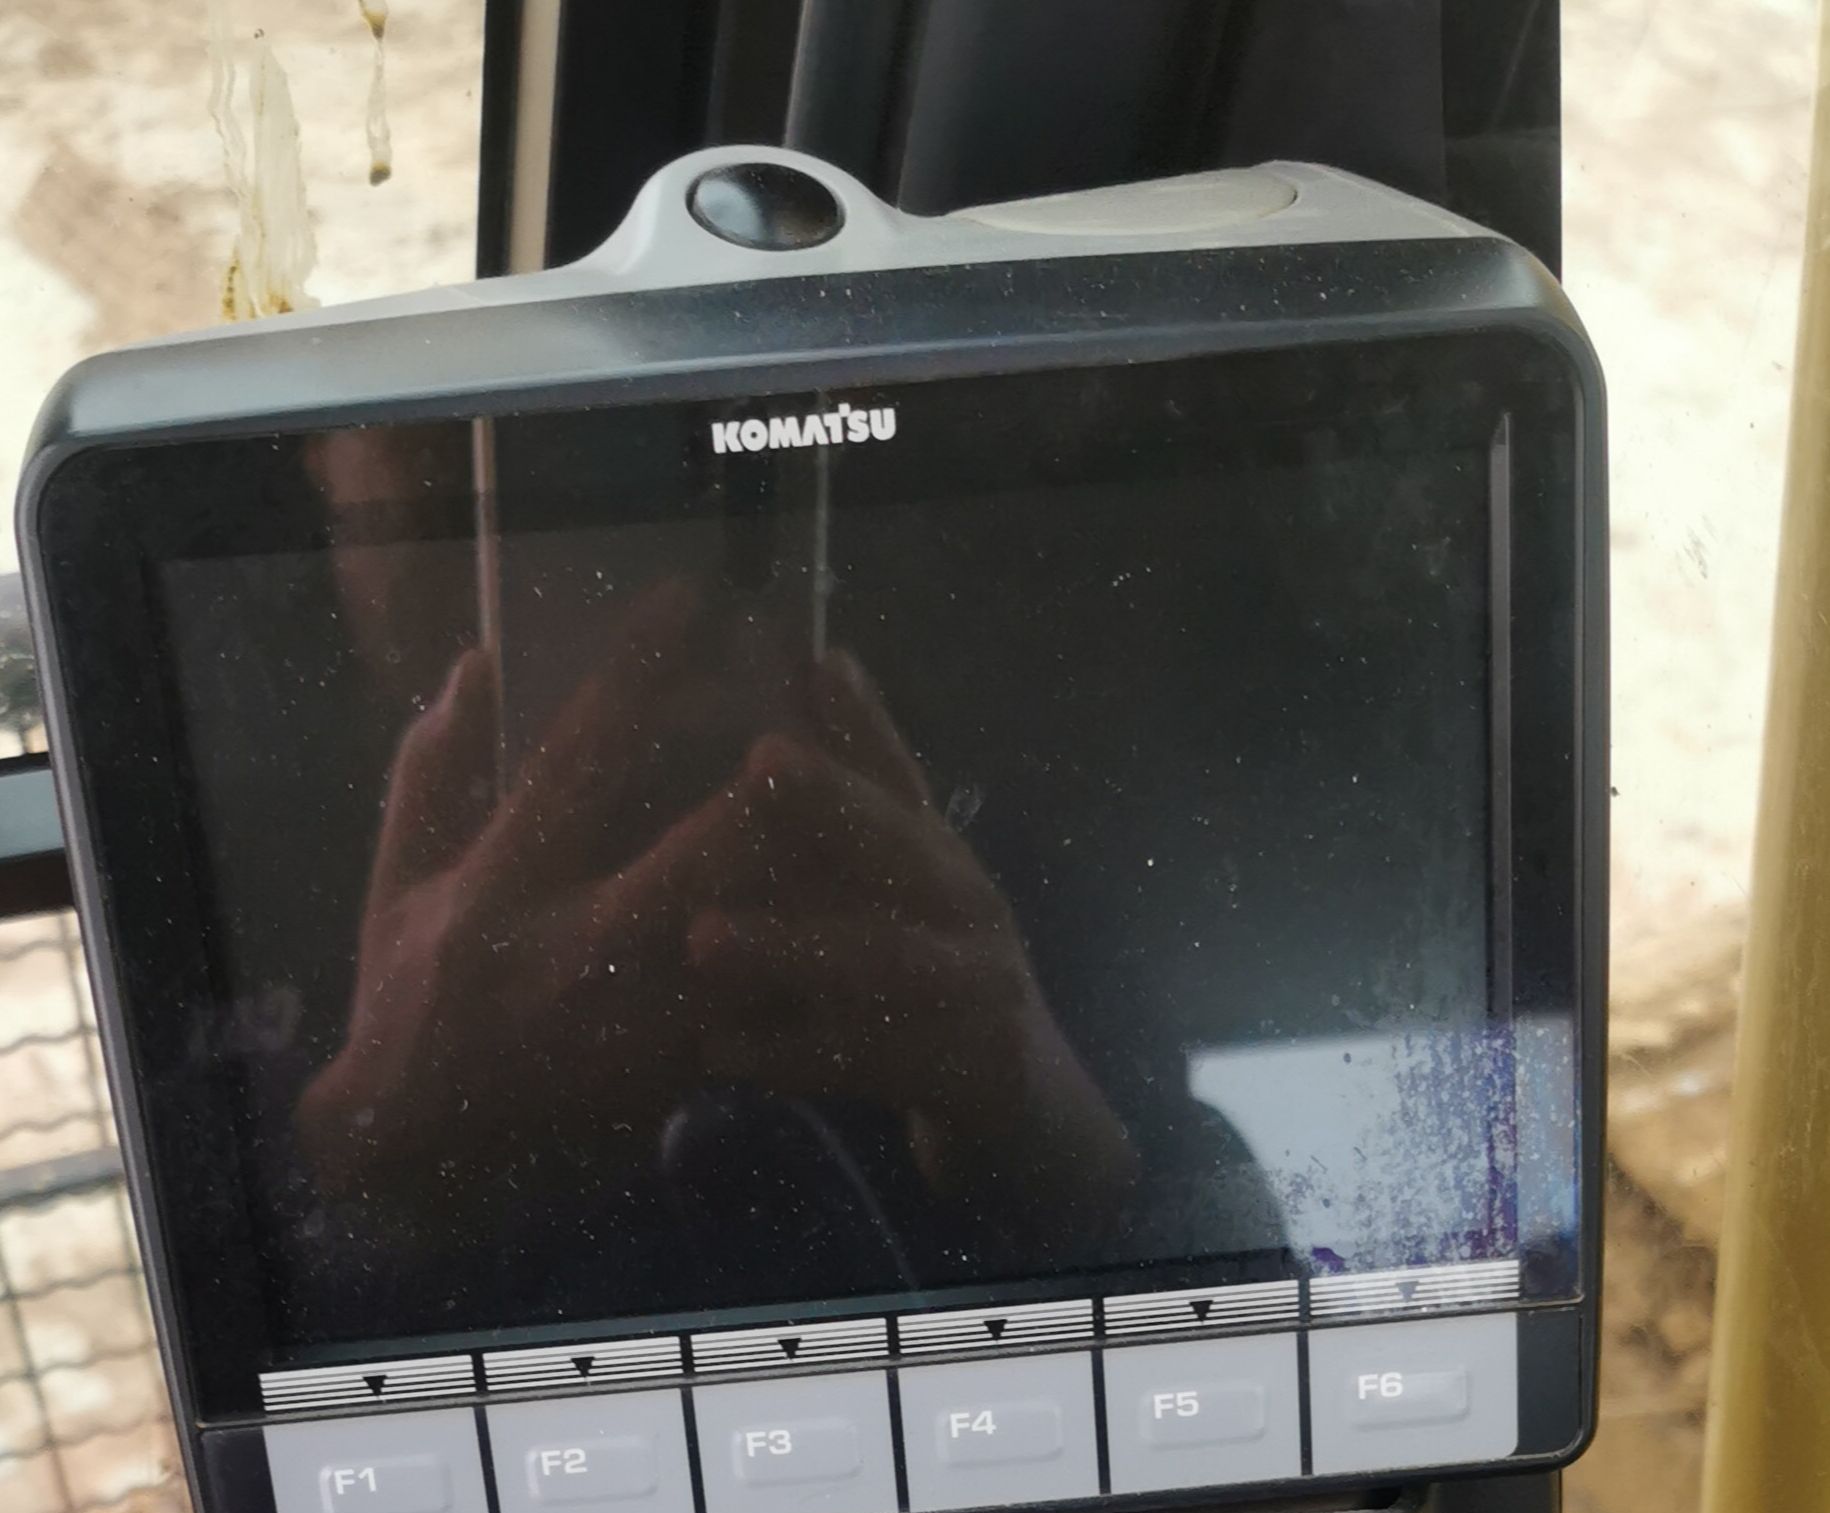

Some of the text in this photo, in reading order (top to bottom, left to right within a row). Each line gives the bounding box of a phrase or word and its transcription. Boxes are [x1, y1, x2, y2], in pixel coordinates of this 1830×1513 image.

[711, 402, 896, 454] KOMATSU
[1358, 1372, 1403, 1400] F6
[1153, 1391, 1199, 1419] F5
[949, 1410, 997, 1438] F4
[745, 1429, 792, 1457] F3
[540, 1448, 587, 1476] F2
[333, 1467, 377, 1495] F1
